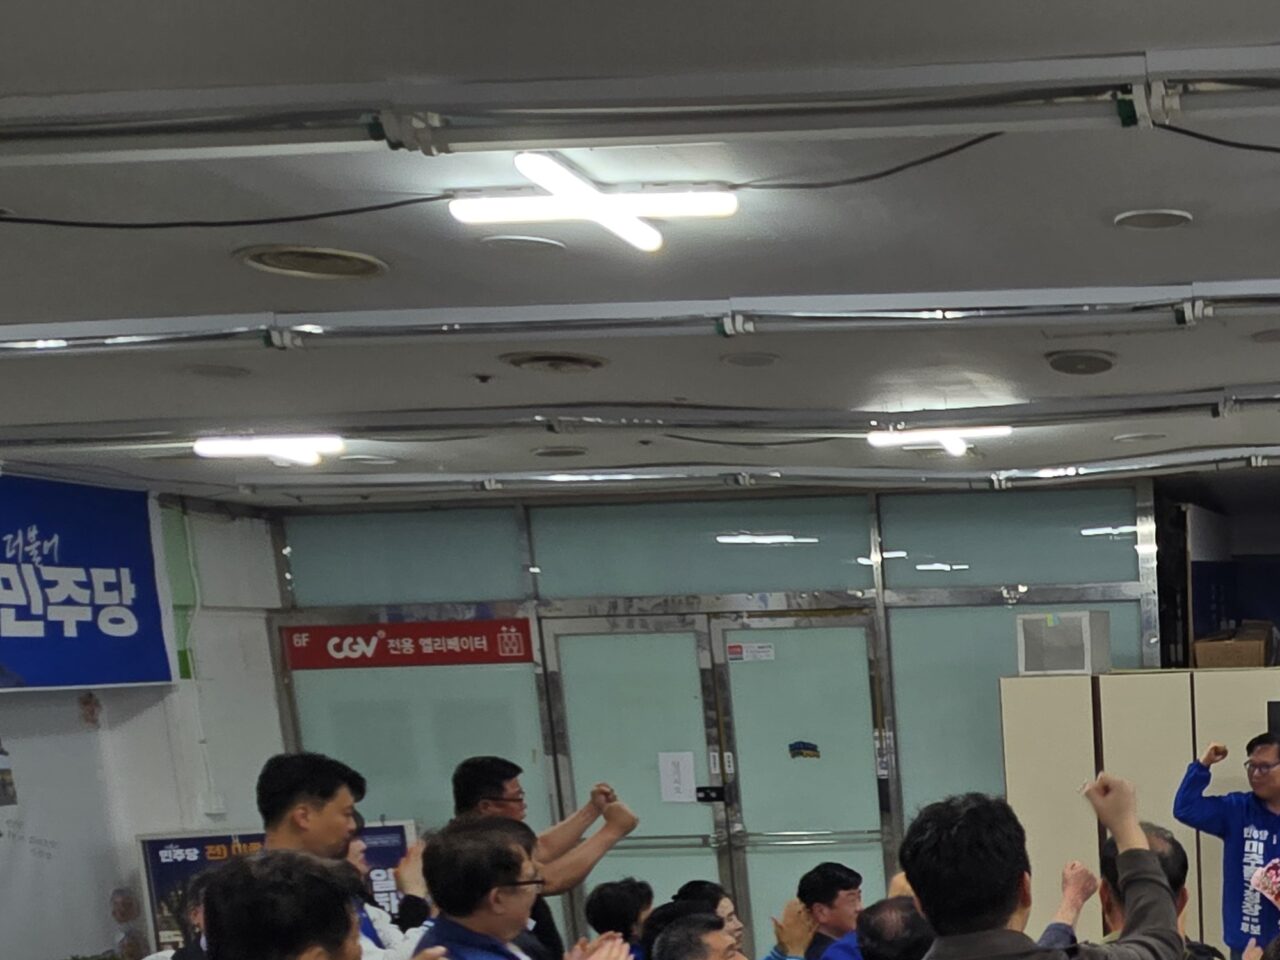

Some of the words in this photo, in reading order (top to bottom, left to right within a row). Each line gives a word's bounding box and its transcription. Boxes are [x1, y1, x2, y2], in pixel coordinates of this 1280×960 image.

[0, 562, 139, 637] 민주당
[327, 636, 378, 659] CGV
[387, 638, 415, 654] 전용
[158, 848, 199, 862] 민주당
